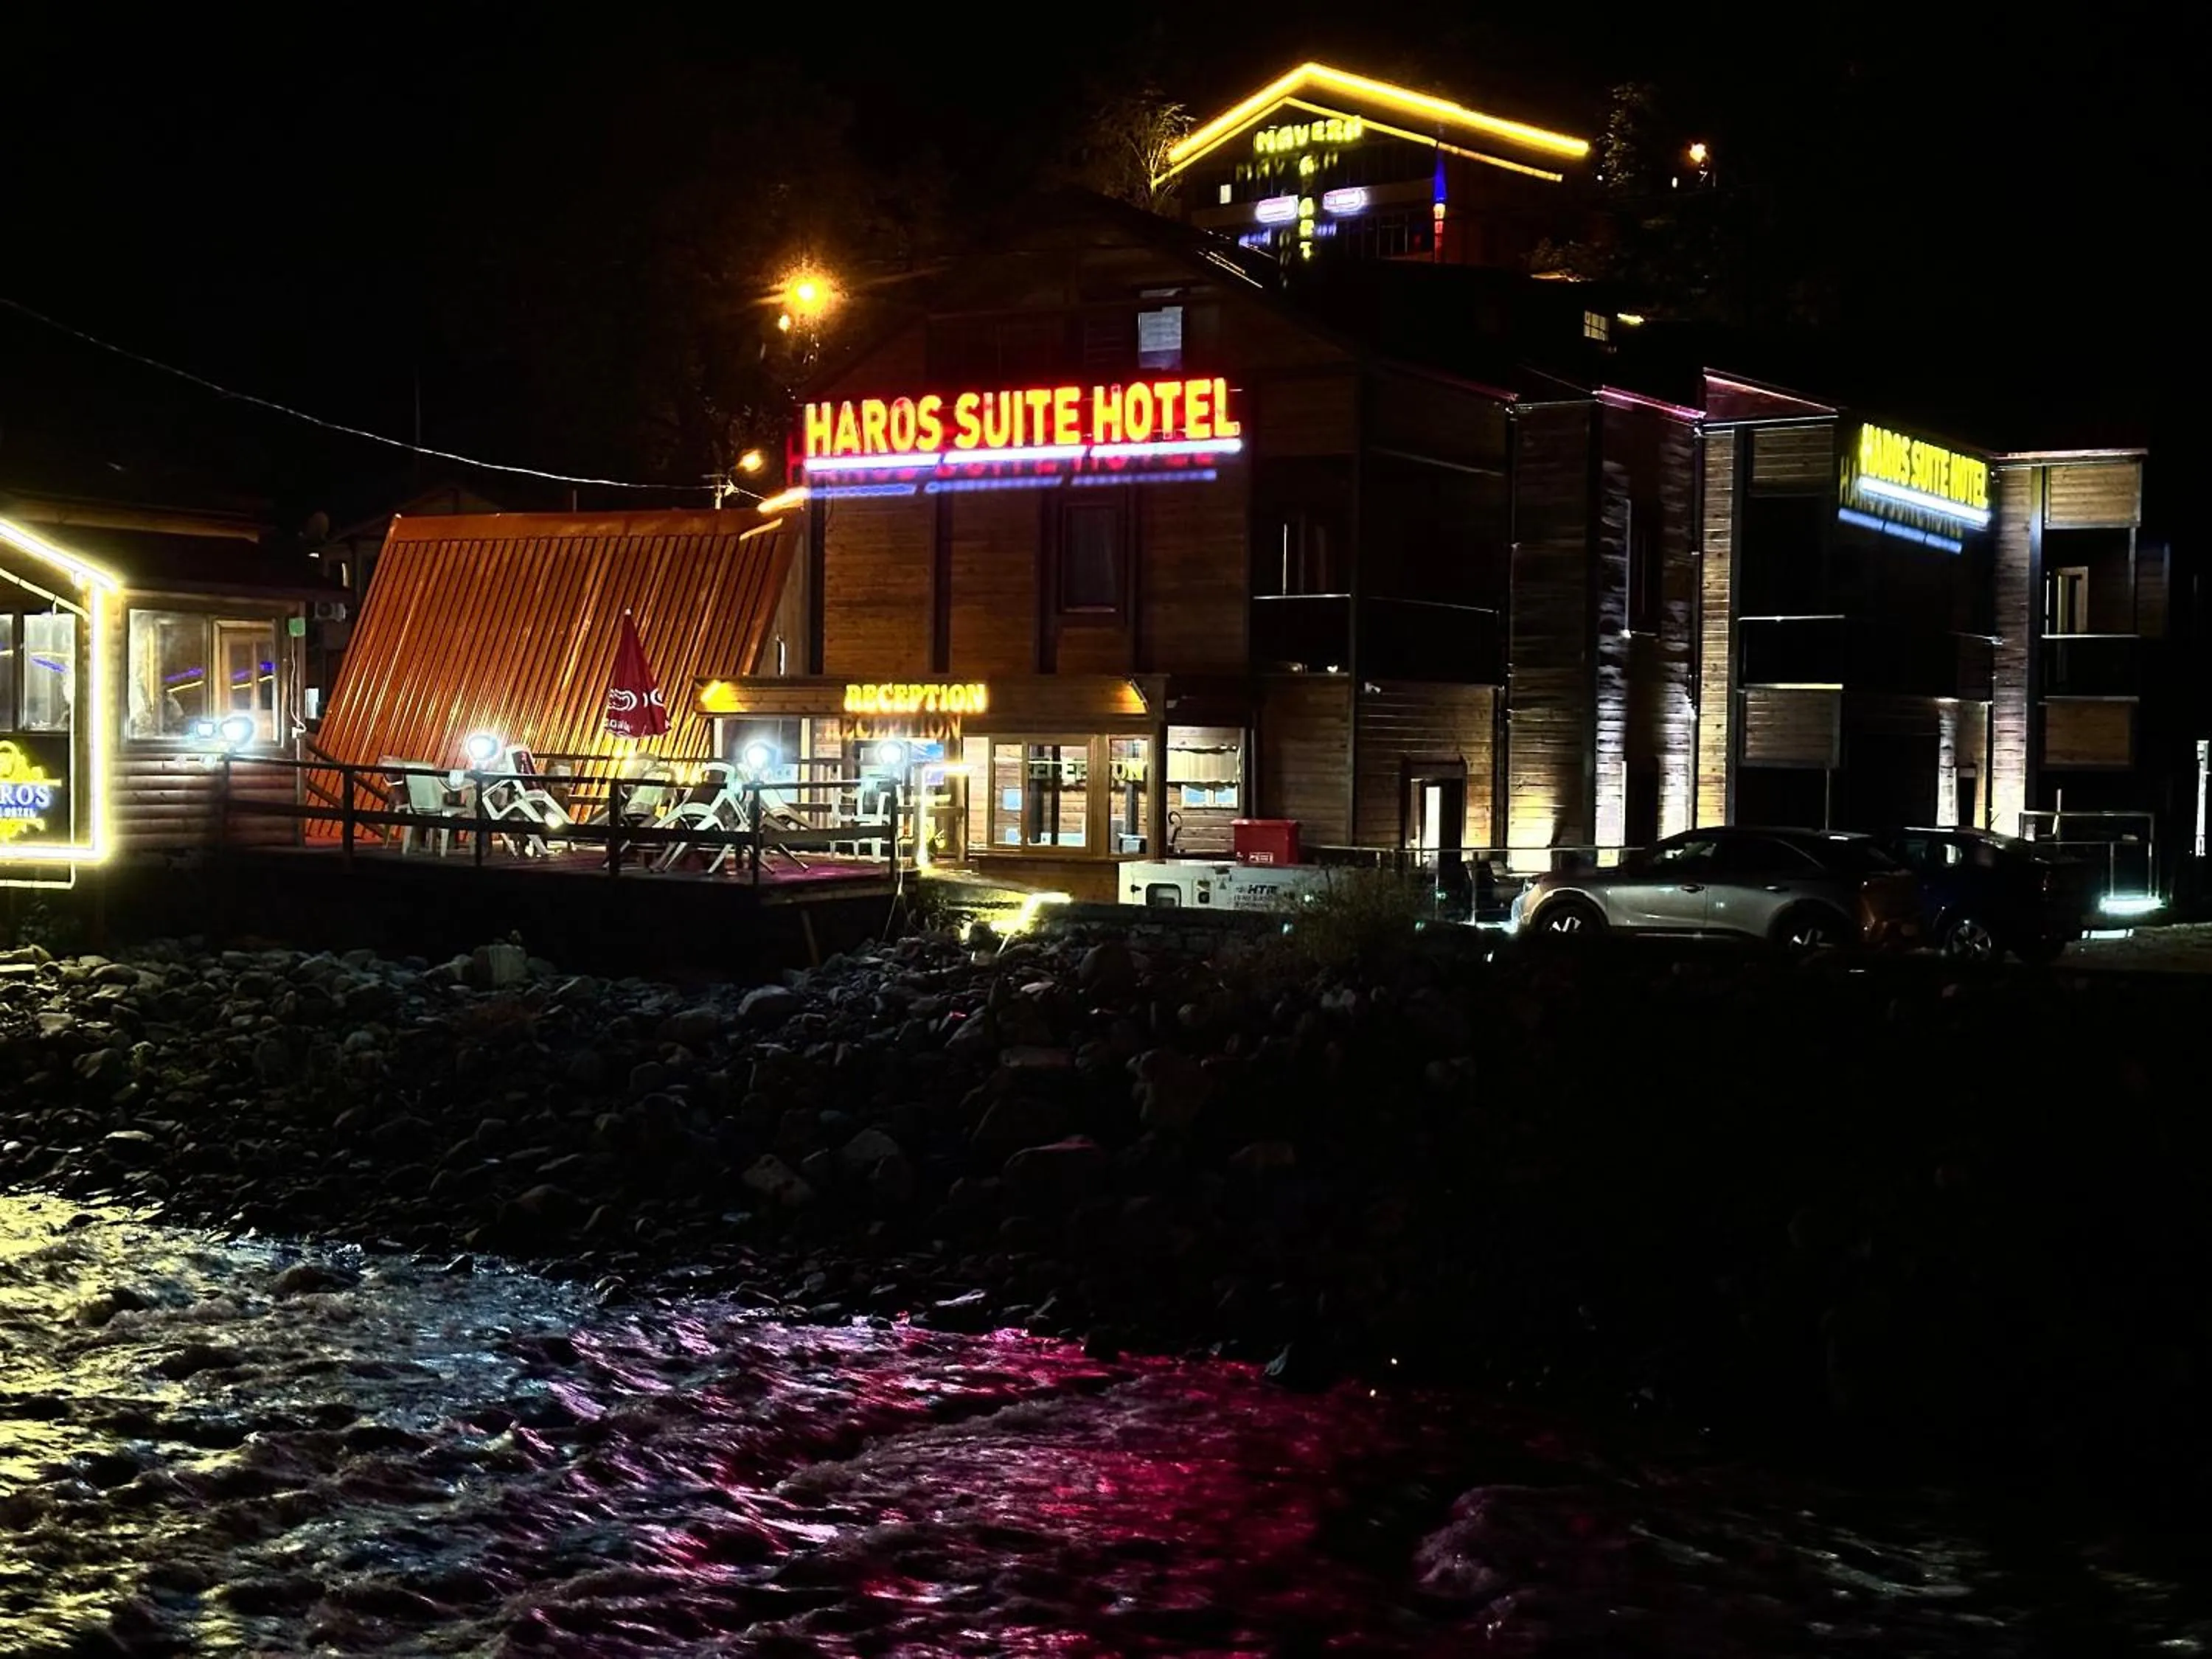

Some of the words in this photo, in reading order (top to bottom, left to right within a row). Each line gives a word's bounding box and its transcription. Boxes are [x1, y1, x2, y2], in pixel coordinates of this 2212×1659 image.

[804, 395, 943, 457] HAROS
[955, 386, 1081, 449] SUITE
[1093, 378, 1240, 443] HOTEL
[1860, 423, 1910, 485] HAROS
[1911, 440, 1950, 498] SUITE
[1950, 452, 1989, 509] HOTEL
[844, 684, 988, 713] RECEPTION
